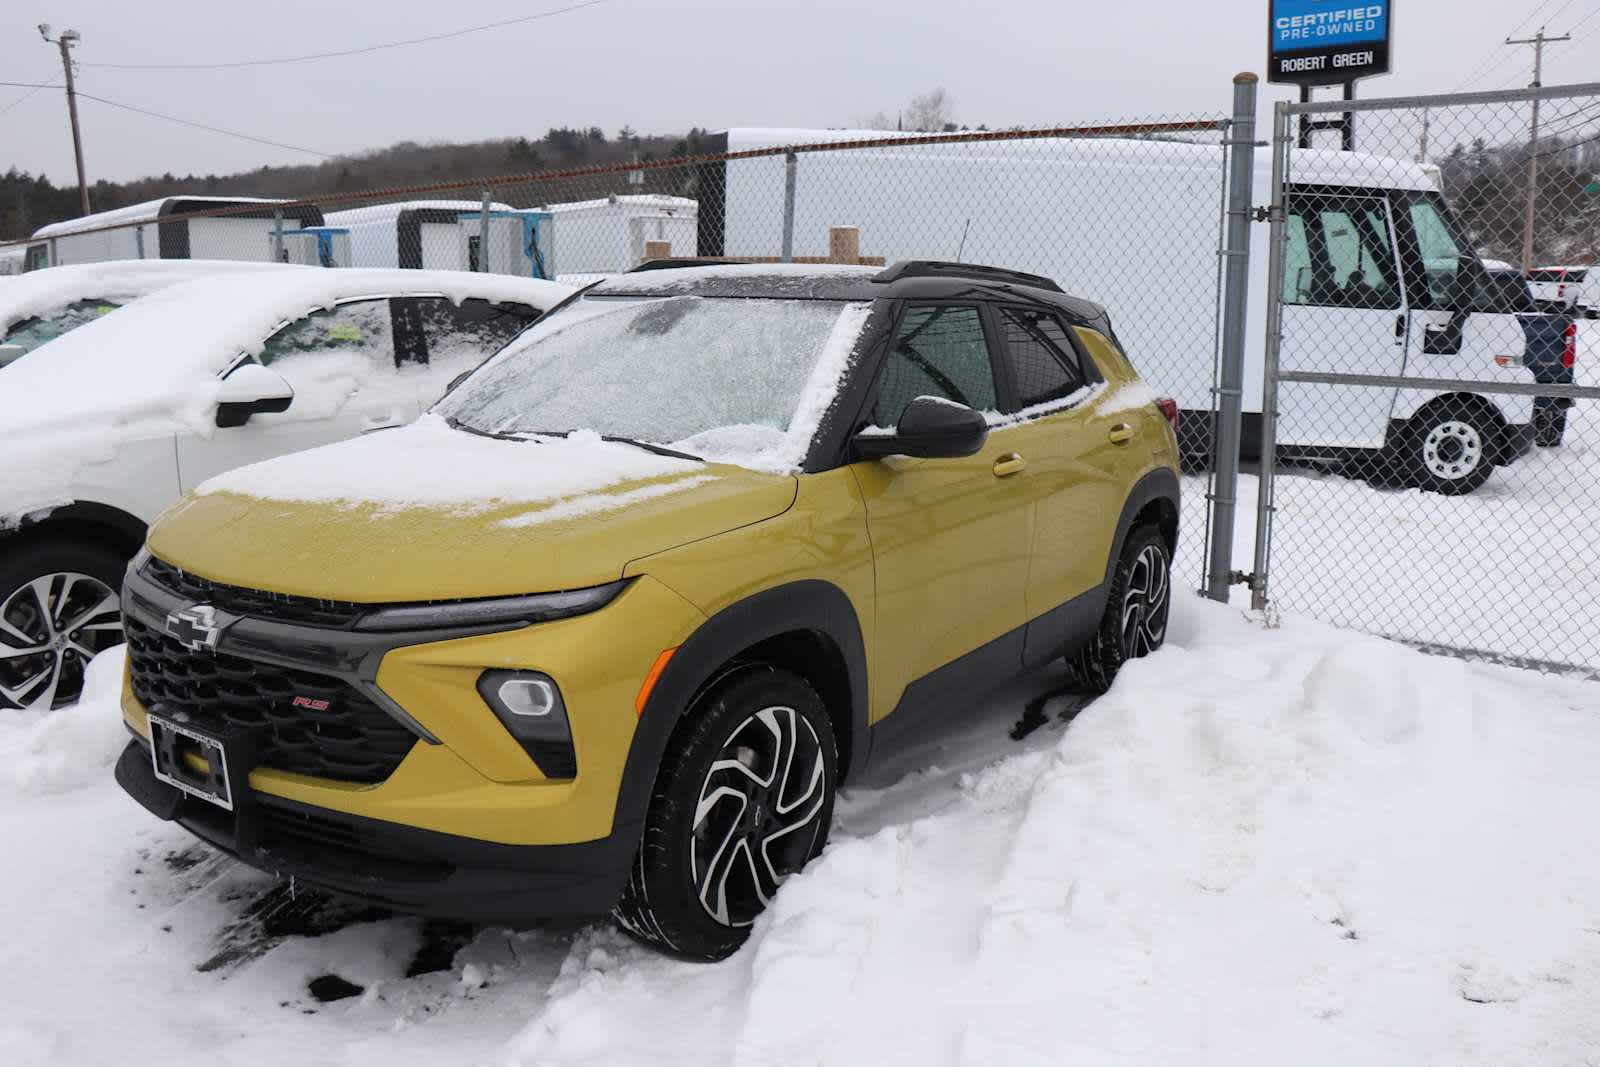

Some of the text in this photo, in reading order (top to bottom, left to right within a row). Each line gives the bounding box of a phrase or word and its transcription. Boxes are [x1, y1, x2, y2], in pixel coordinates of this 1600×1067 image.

[1276, 5, 1382, 29] CERTIFIED
[1280, 20, 1376, 40] PRE-OWNED
[1281, 51, 1374, 72] ROBERT GREEN
[292, 696, 330, 711] RS
